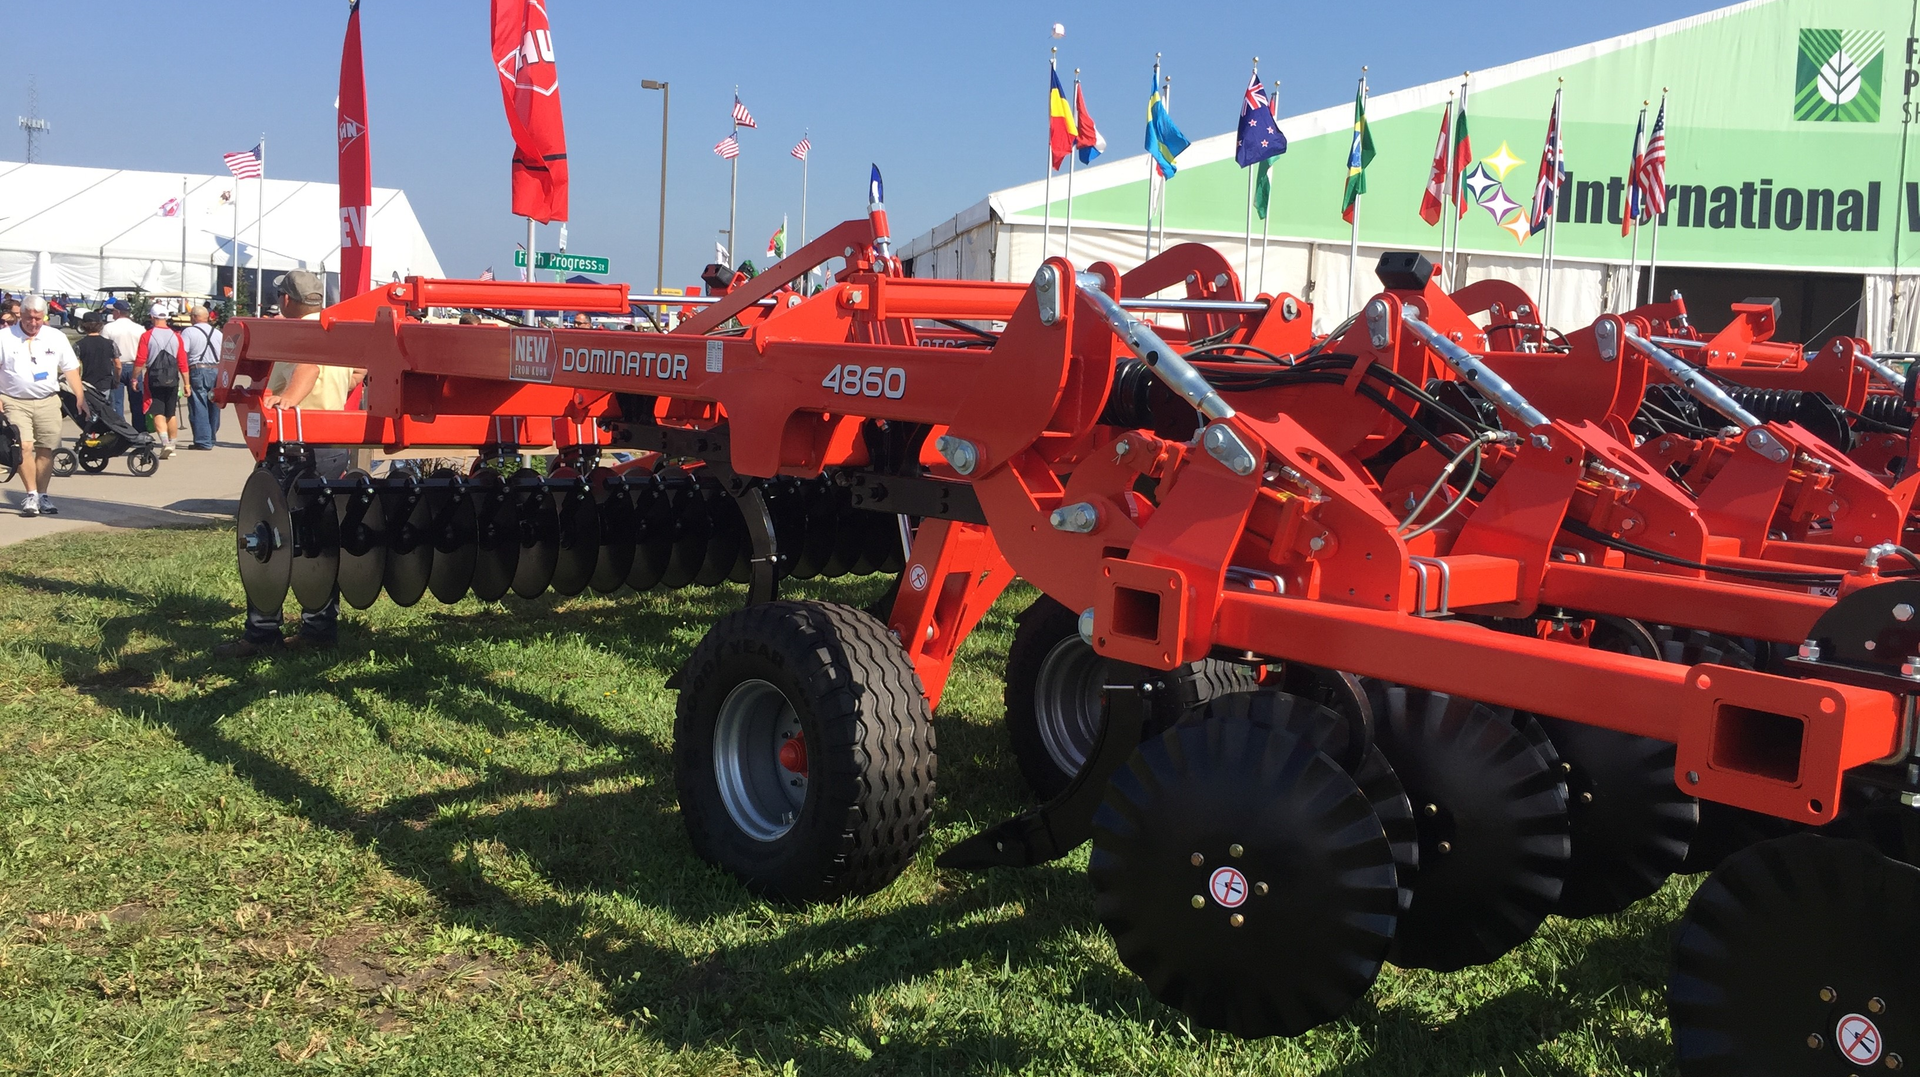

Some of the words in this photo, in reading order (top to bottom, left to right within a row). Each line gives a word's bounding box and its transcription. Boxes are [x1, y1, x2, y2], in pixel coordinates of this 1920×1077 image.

[549, 253, 598, 271] Progress
[598, 263, 605, 271] St
[515, 335, 549, 363] NEW
[515, 364, 530, 375] FROM
[562, 347, 688, 380] DOMINATOR
[822, 363, 907, 399] 4860
